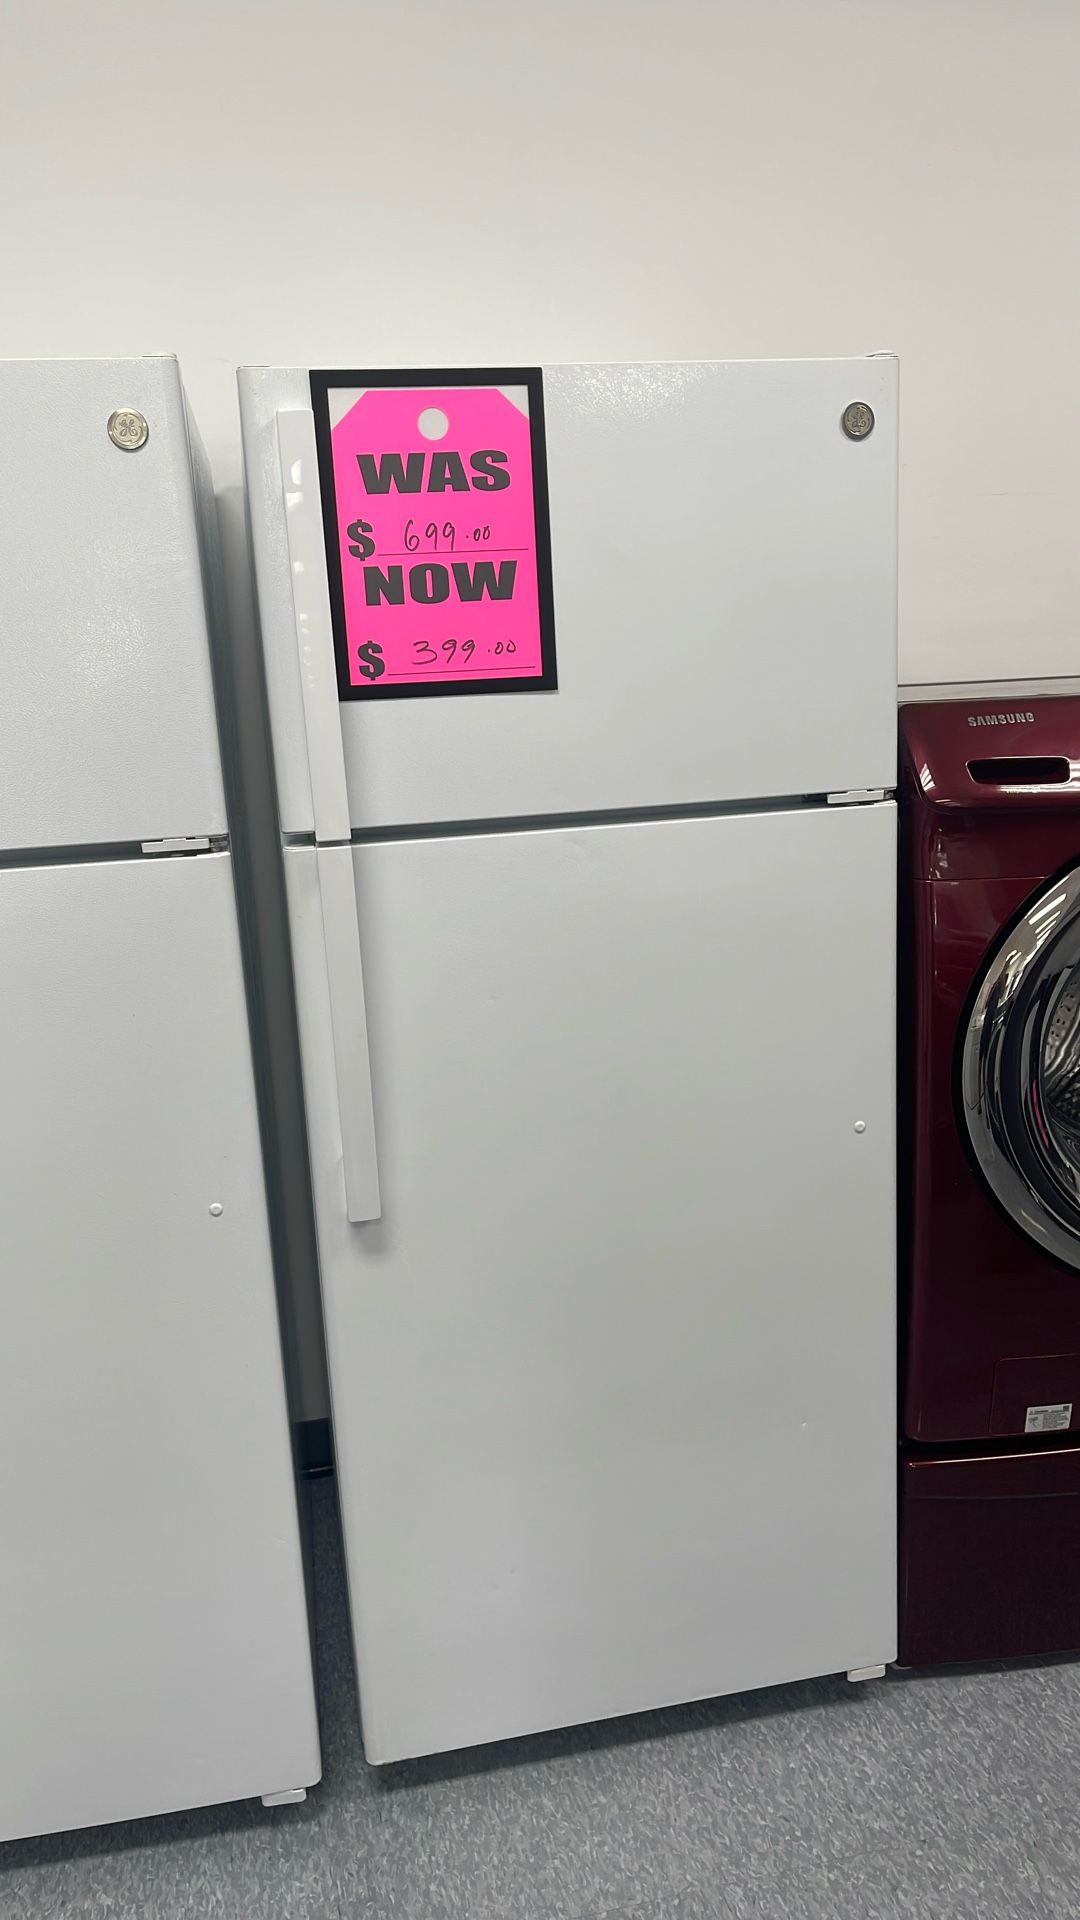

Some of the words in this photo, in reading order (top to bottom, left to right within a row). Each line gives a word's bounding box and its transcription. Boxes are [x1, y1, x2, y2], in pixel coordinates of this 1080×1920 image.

[356, 450, 511, 494] WAS
[347, 519, 376, 561] $
[363, 560, 517, 606] NOW
[357, 640, 386, 681] $
[967, 712, 1035, 727] SAMSUNG
